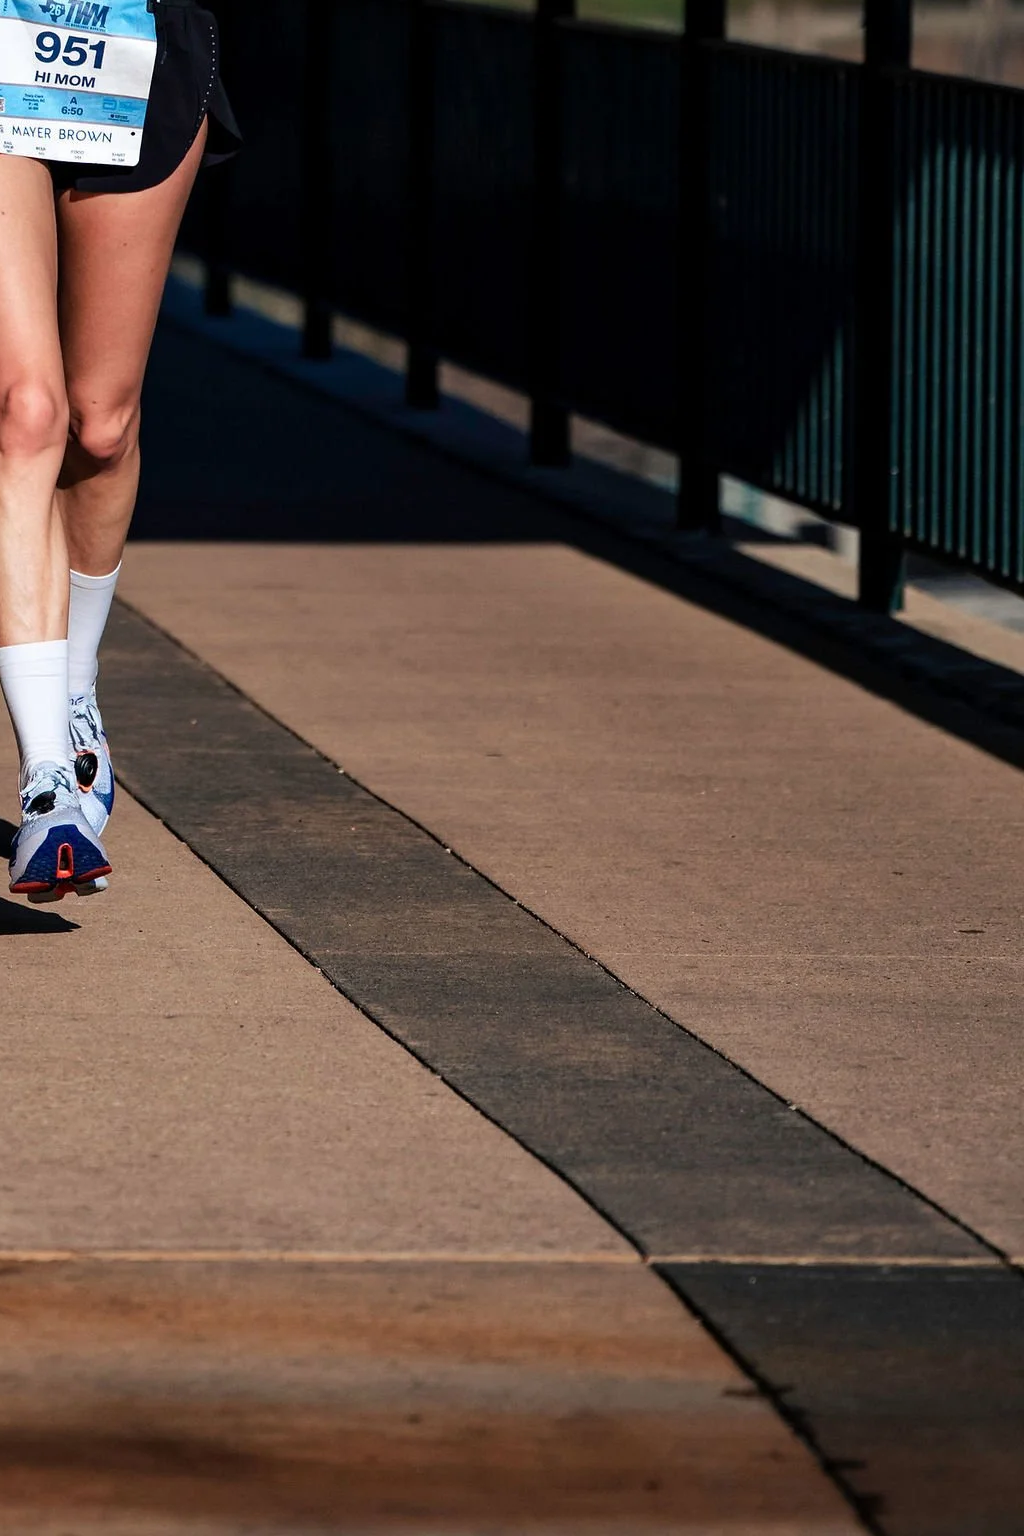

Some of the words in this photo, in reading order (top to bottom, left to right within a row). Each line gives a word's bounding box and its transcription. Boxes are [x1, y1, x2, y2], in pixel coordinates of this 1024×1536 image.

[34, 30, 106, 69] 951
[34, 70, 51, 83] HI
[54, 73, 96, 88] MOM
[69, 96, 78, 105] A
[61, 106, 84, 116] 6:50
[12, 125, 52, 139] MAYER
[58, 128, 112, 143] BROWN
